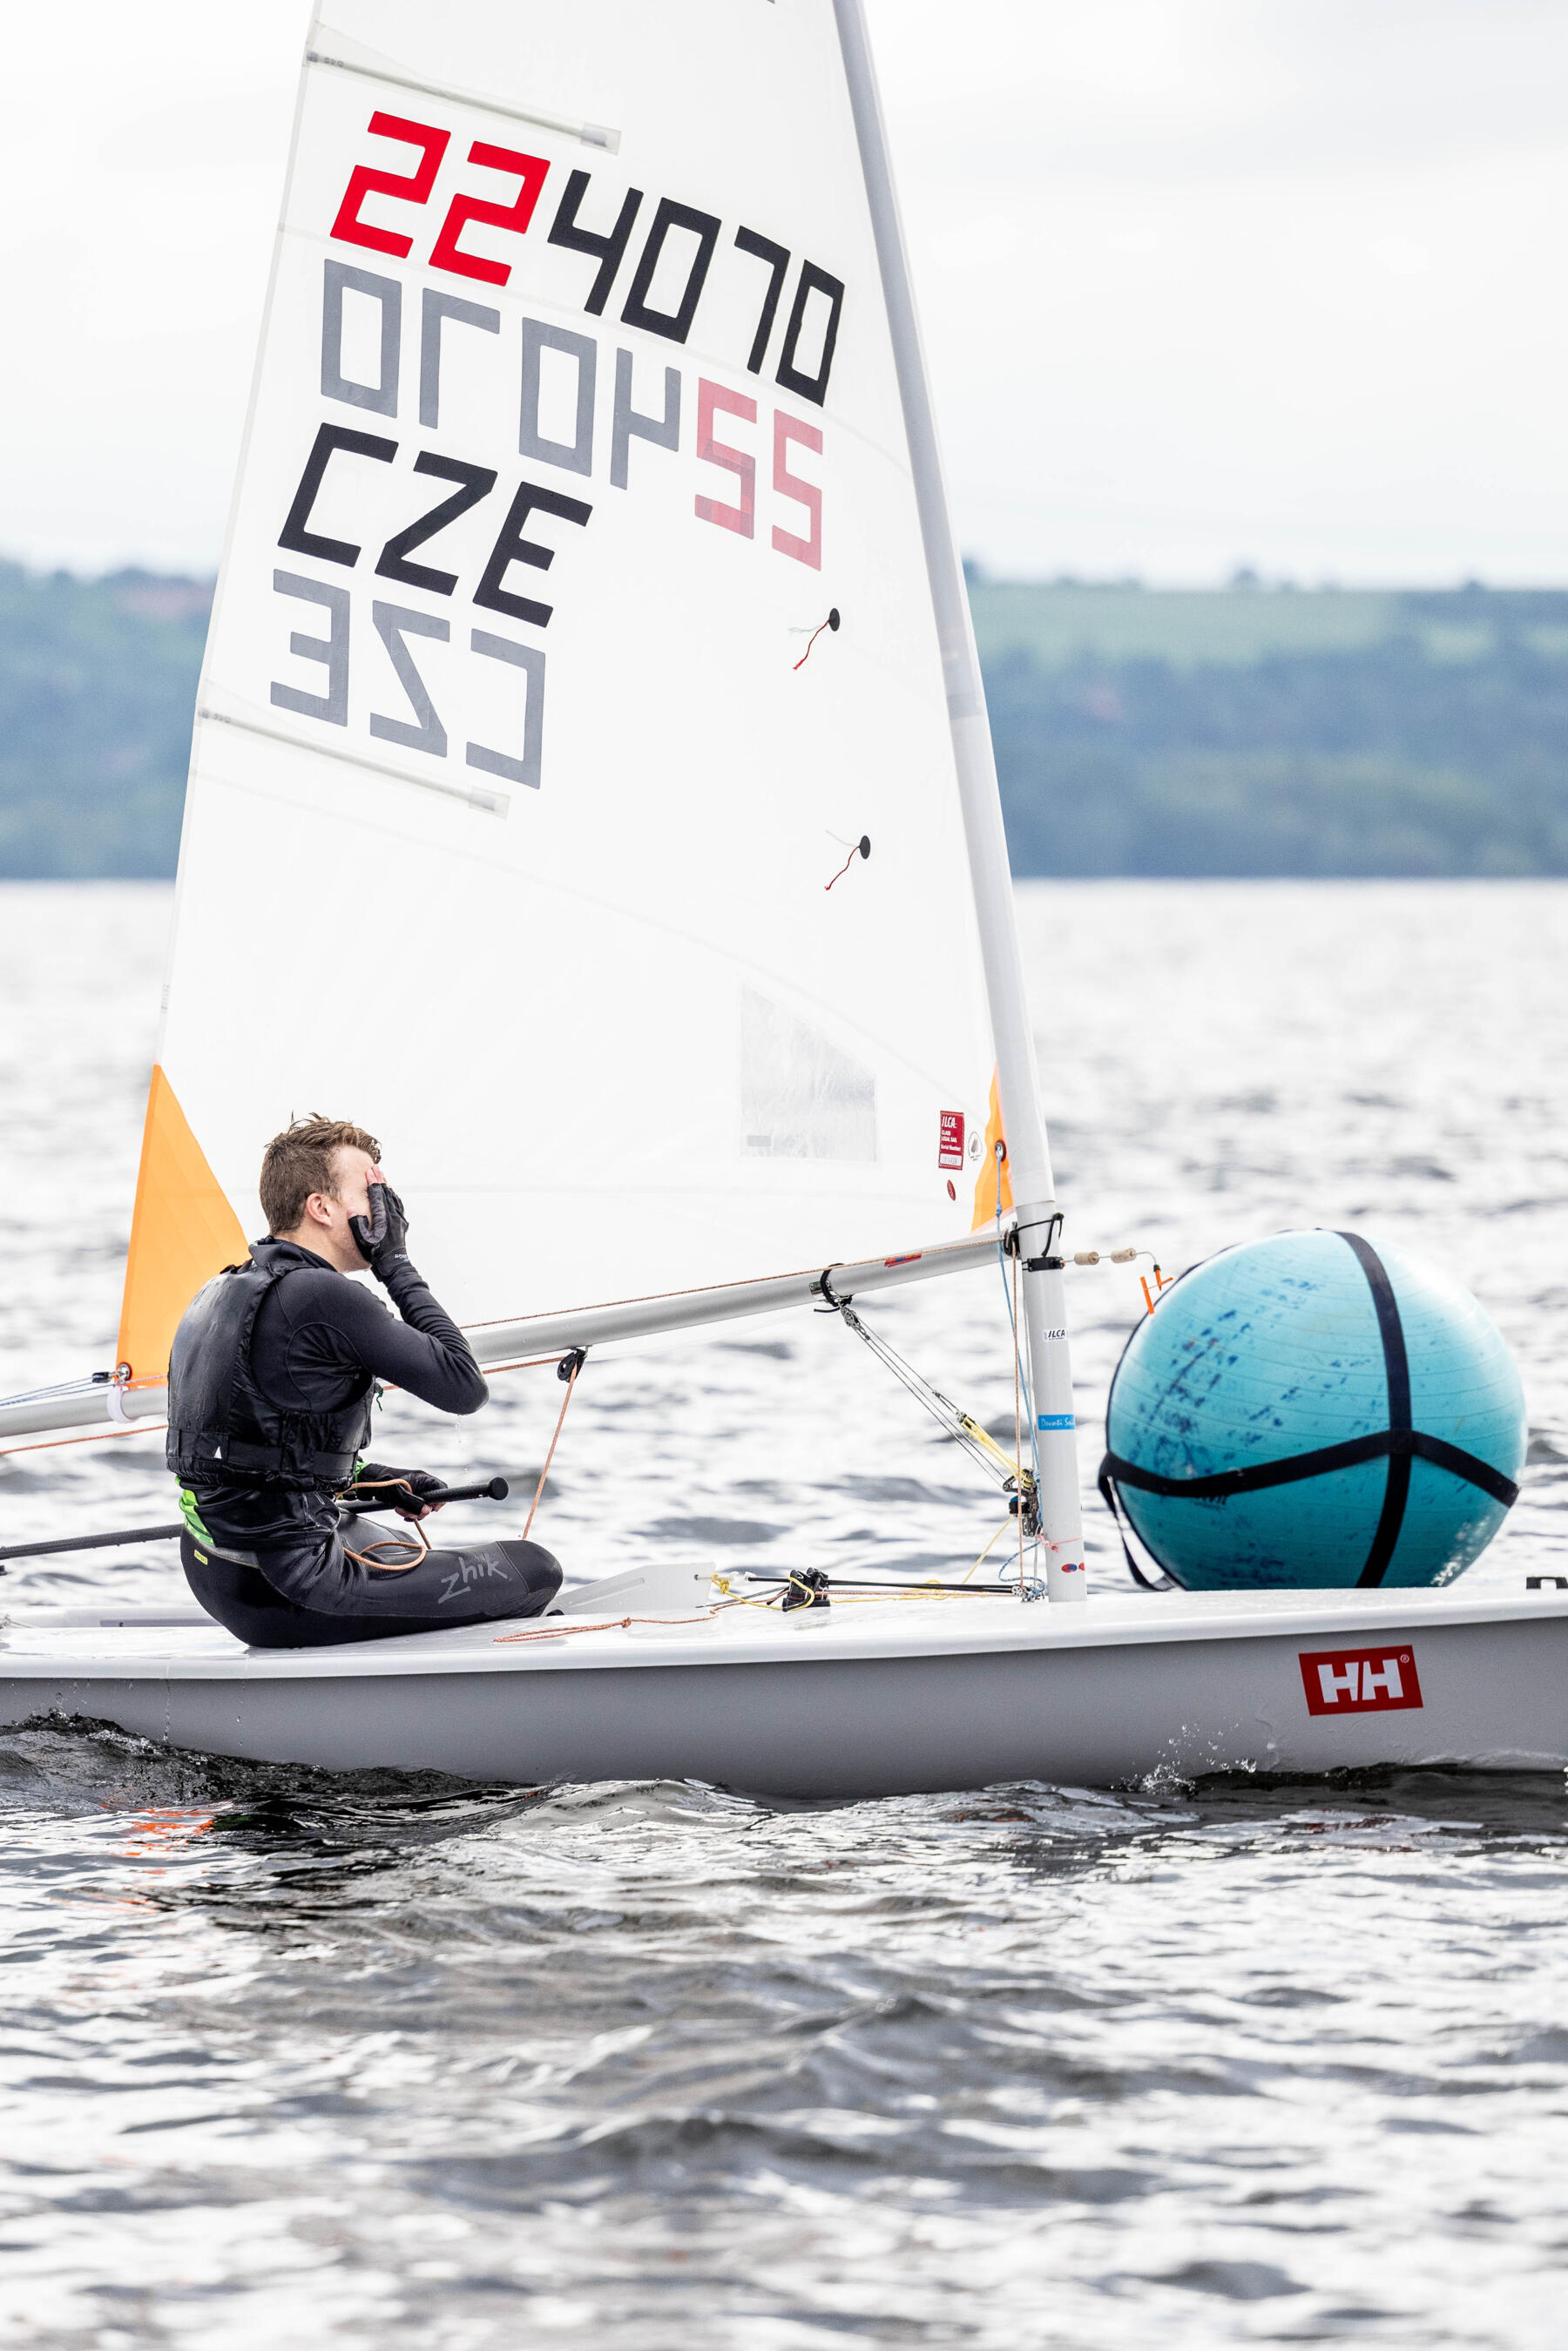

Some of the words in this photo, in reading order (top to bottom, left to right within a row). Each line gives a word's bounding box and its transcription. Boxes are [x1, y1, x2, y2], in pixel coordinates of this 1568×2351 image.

[328, 110, 846, 409] 224070
[276, 422, 594, 629] CZE
[942, 1116, 956, 1128] ILCA
[1048, 1329, 1065, 1338] ILCA
